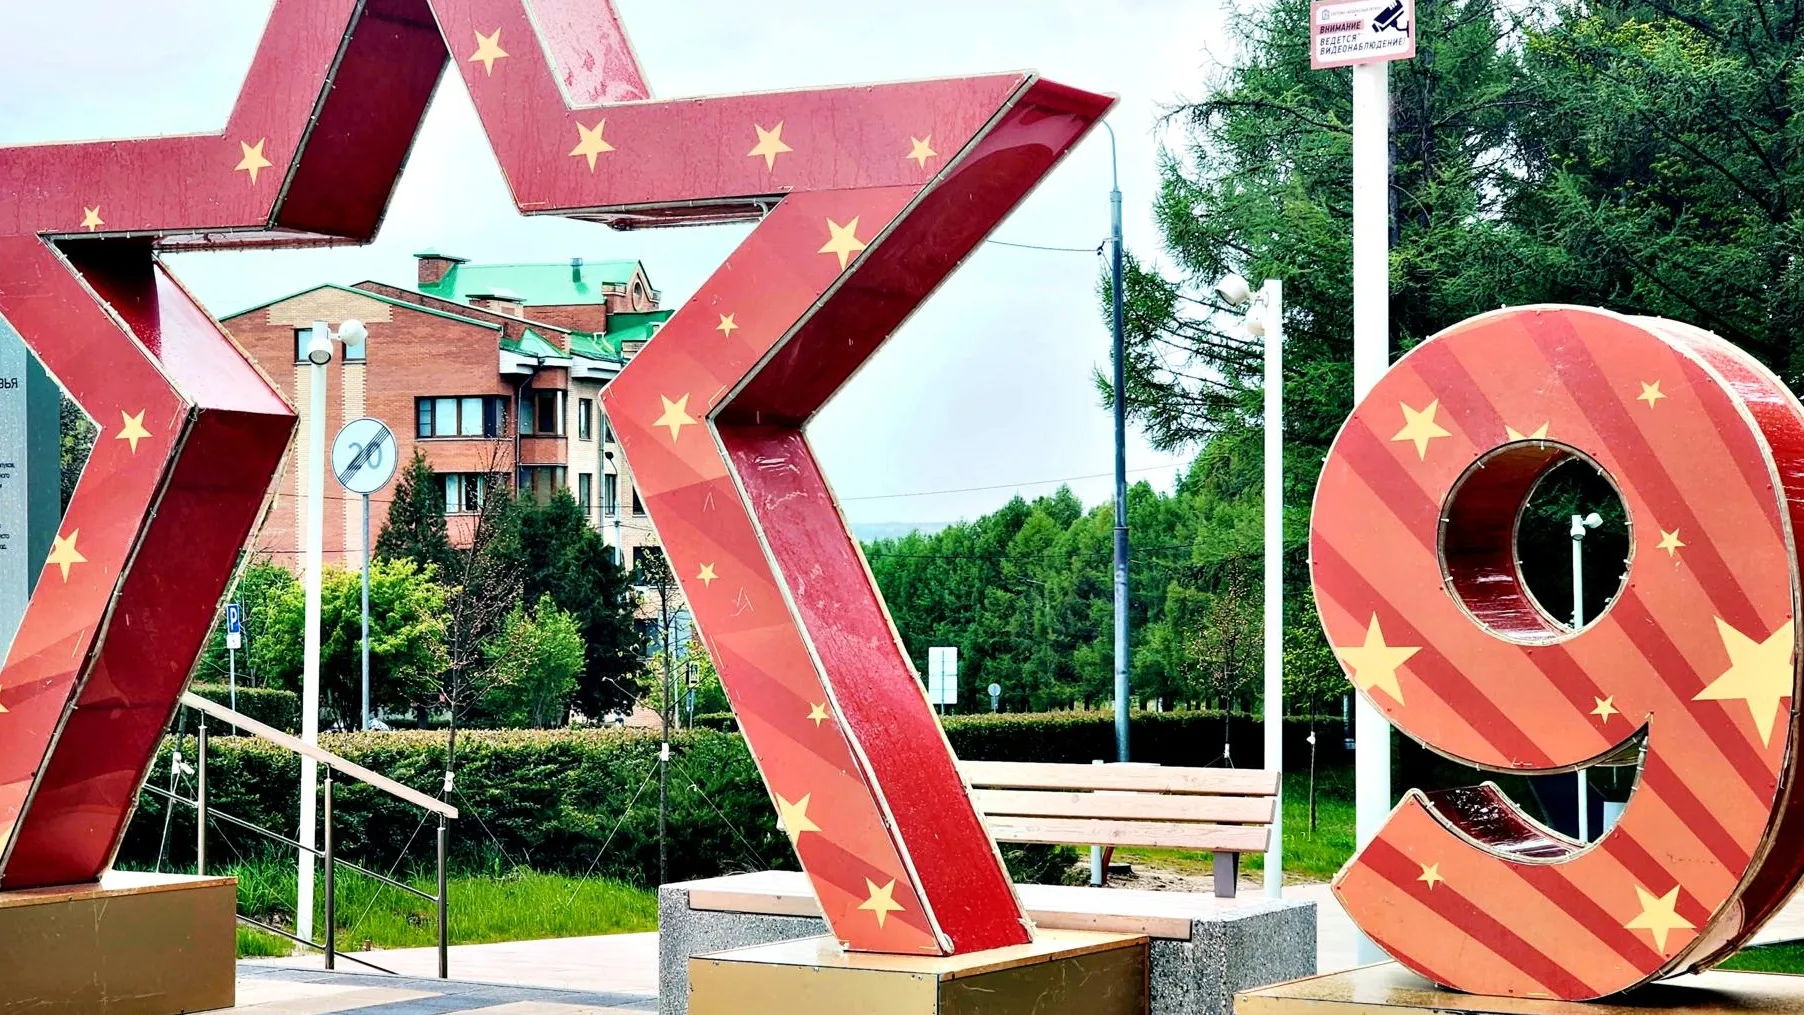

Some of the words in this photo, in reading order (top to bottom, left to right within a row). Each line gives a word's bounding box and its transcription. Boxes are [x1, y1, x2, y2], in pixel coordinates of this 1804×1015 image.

[1319, 21, 1361, 34] ВНИМАНИЕ
[1320, 34, 1357, 46] ВЕДЕТСЯ
[1320, 37, 1406, 55] ВИДЕОНАБЛЮДЕНИЕ!
[347, 442, 382, 470] 20
[230, 607, 237, 631] P
[1310, 304, 1804, 1000] 9
